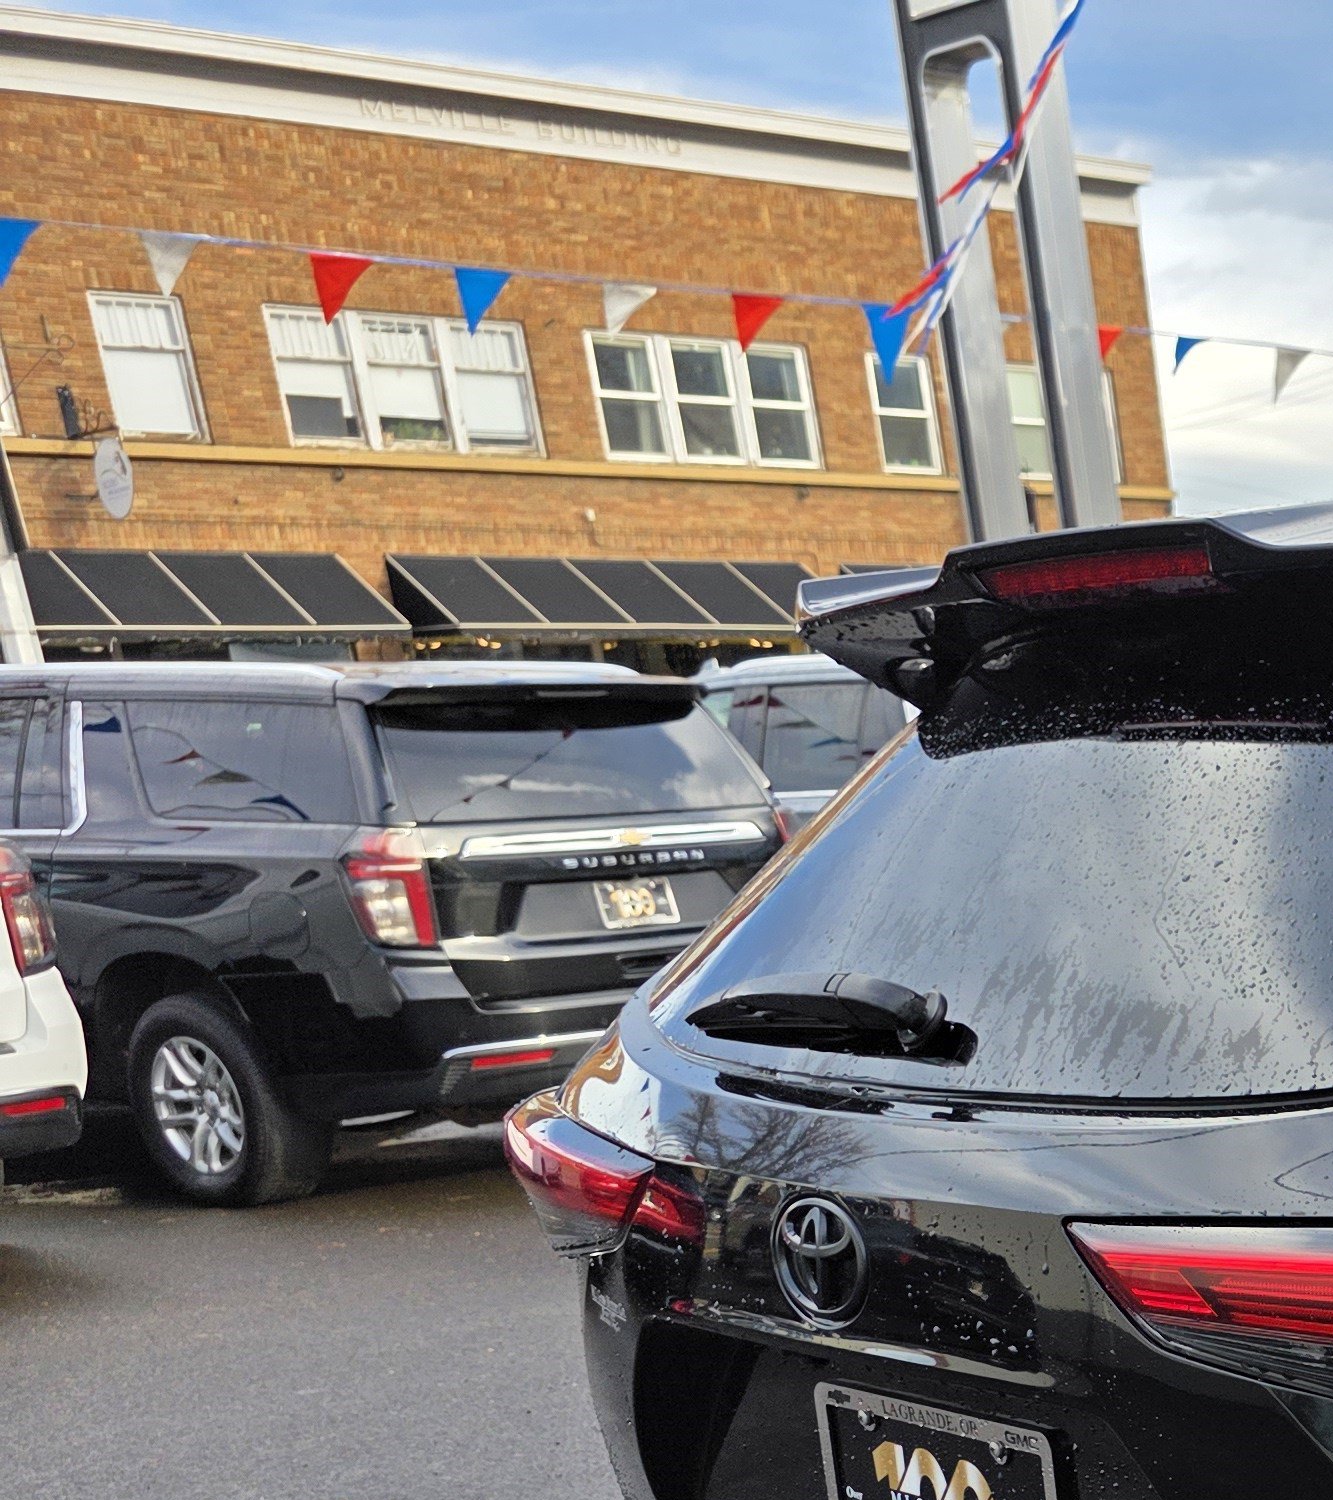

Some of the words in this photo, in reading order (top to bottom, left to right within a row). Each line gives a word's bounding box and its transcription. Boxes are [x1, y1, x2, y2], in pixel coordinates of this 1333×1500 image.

[361, 98, 517, 136] MELVILLE
[538, 119, 683, 157] BUILDING
[562, 849, 705, 870] SUBURBAN
[1004, 1430, 1039, 1450] GMC
